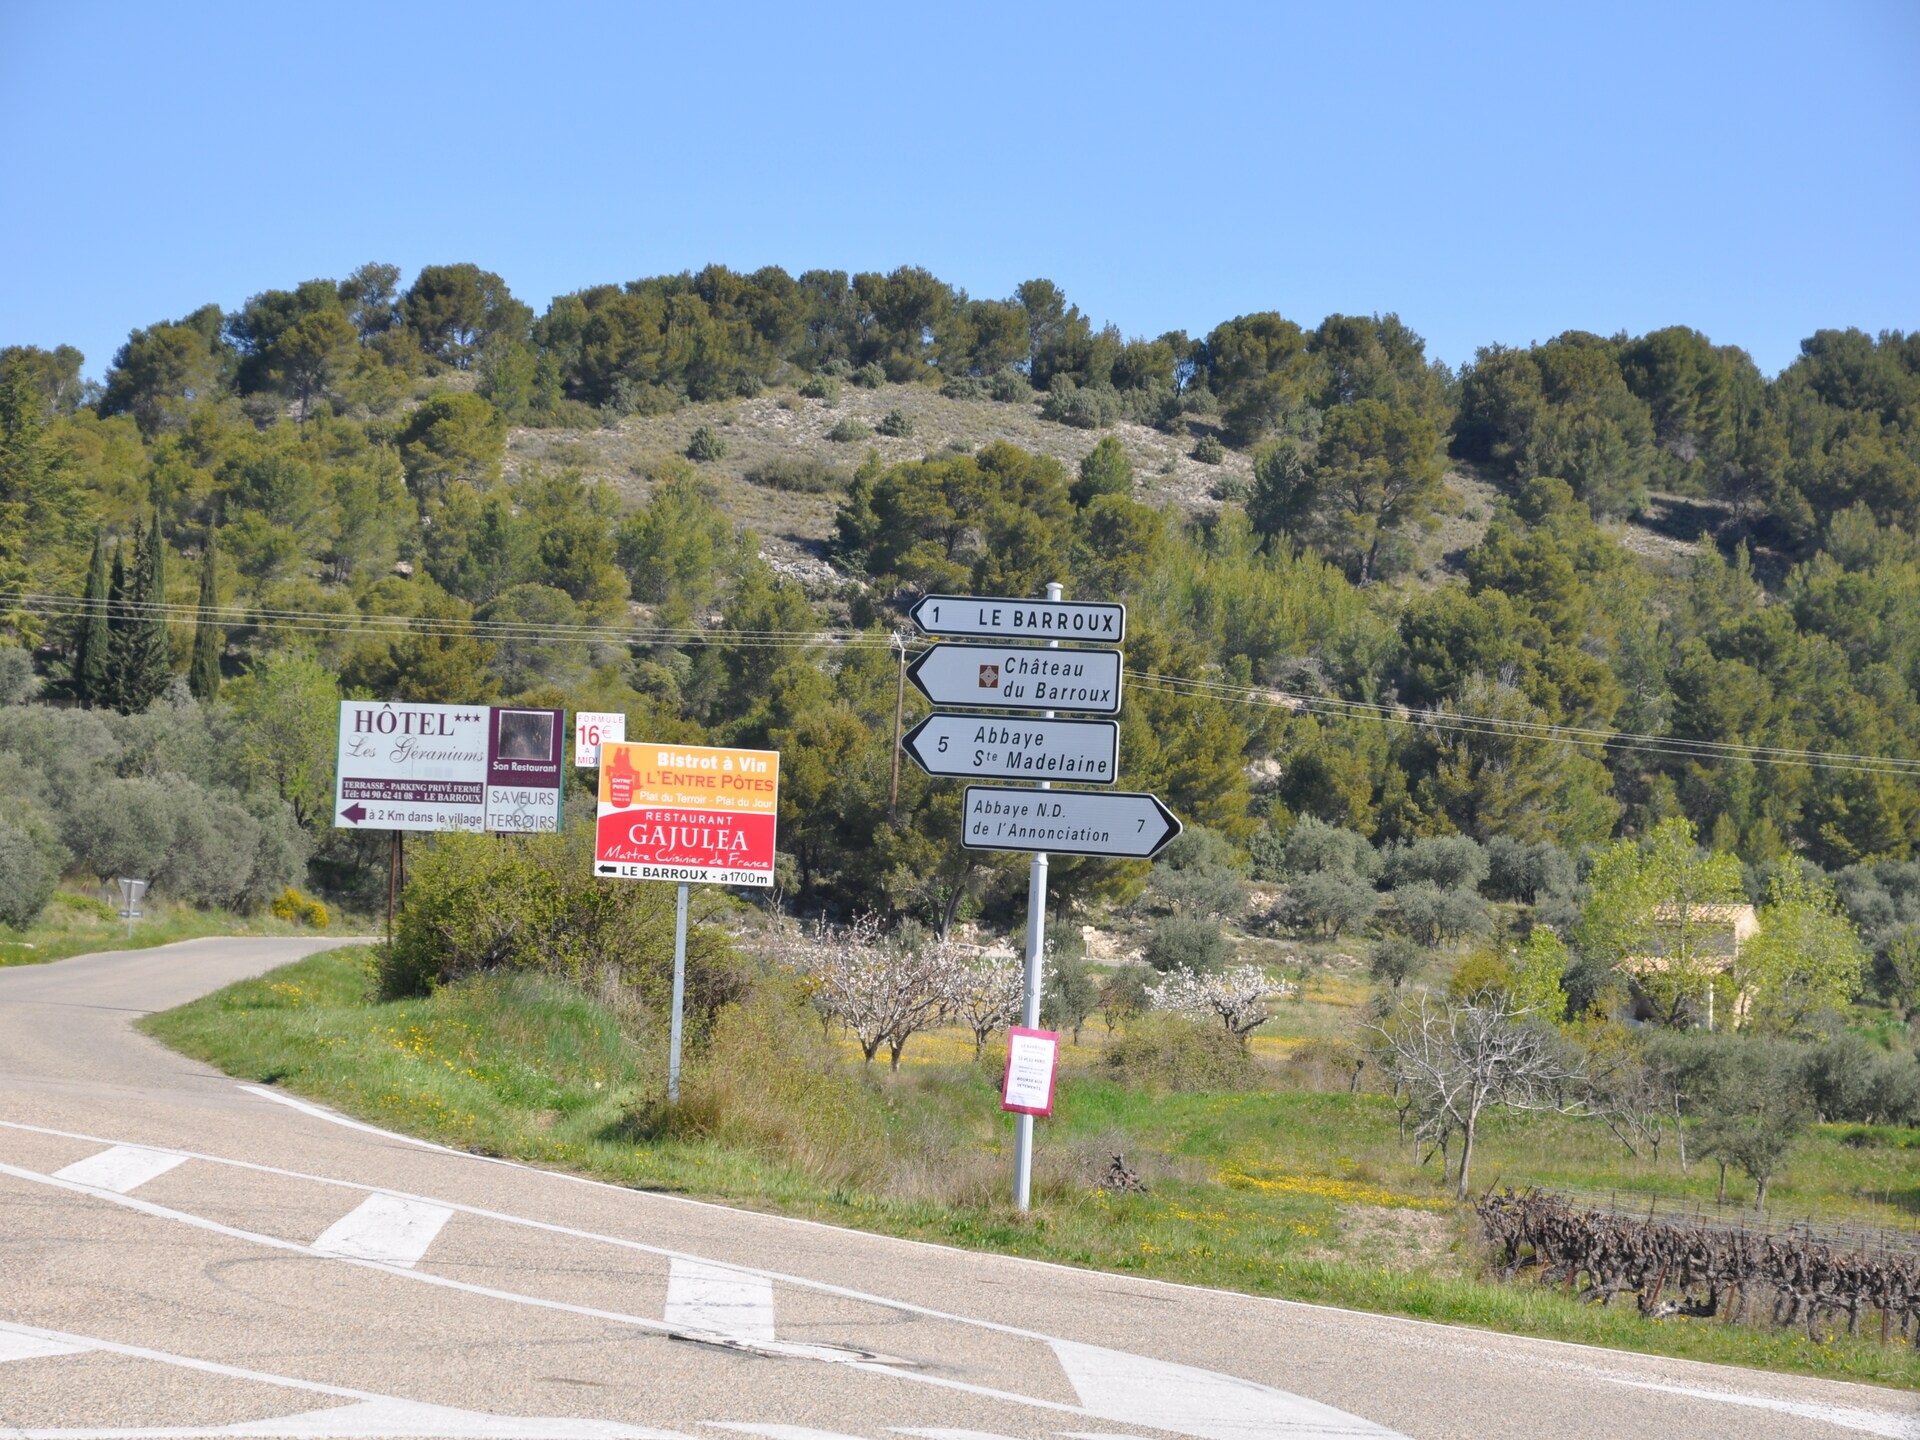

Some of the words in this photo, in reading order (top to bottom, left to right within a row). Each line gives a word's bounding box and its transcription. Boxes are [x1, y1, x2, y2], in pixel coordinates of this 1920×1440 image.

[933, 607, 940, 623] 1
[979, 609, 1001, 626] LE
[1014, 611, 1113, 632] BARROUX
[1005, 658, 1084, 676] Château
[1004, 682, 1024, 698] du
[1035, 682, 1110, 702] Barroux
[354, 703, 455, 736] HÔTEL
[938, 737, 949, 752] 5
[974, 727, 1044, 748] Abbaye
[345, 735, 376, 758] Les
[389, 736, 483, 763] Géraniums
[493, 761, 509, 770] Son
[512, 762, 557, 772] Restaurant
[658, 752, 718, 770] Bistrot
[723, 756, 733, 771] à
[739, 757, 766, 772] Vin
[1006, 752, 1107, 773] Madelaine
[344, 781, 384, 789] TERRASSE
[391, 783, 426, 791] PARKING
[428, 783, 452, 792] PRIVÉ
[453, 784, 481, 793] FERMÉ
[647, 770, 716, 788] L'ENTRE
[722, 775, 774, 791] PÔTES
[371, 791, 381, 799] 90
[404, 792, 413, 800] 08
[424, 793, 435, 801] LE
[438, 794, 481, 802] BARROUX
[492, 790, 554, 805] SAVEURS
[640, 791, 658, 801] Plat
[661, 792, 674, 802] du
[677, 793, 706, 804] Terroir
[716, 796, 735, 806] Plat
[737, 797, 749, 807] du
[752, 798, 772, 808] Jour
[369, 809, 375, 819] à
[378, 810, 384, 820] 2
[388, 811, 404, 821] Km
[408, 811, 433, 822] dans
[436, 812, 445, 823] le
[449, 813, 482, 826] village
[646, 812, 733, 825] RESTAURANT
[974, 800, 1028, 823] Abbaye
[1037, 803, 1066, 818] N.D.
[489, 814, 554, 828] TERROIRS
[1137, 820, 1145, 832] 7
[628, 824, 749, 852] GAJULEA
[973, 823, 988, 835] de
[997, 823, 1109, 842] l'Annonciation
[603, 845, 650, 862] Maître
[655, 849, 704, 865] Cuisinier
[709, 852, 723, 866] de
[727, 853, 769, 868] France
[622, 866, 637, 876] LE
[643, 867, 708, 880] BARROUX
